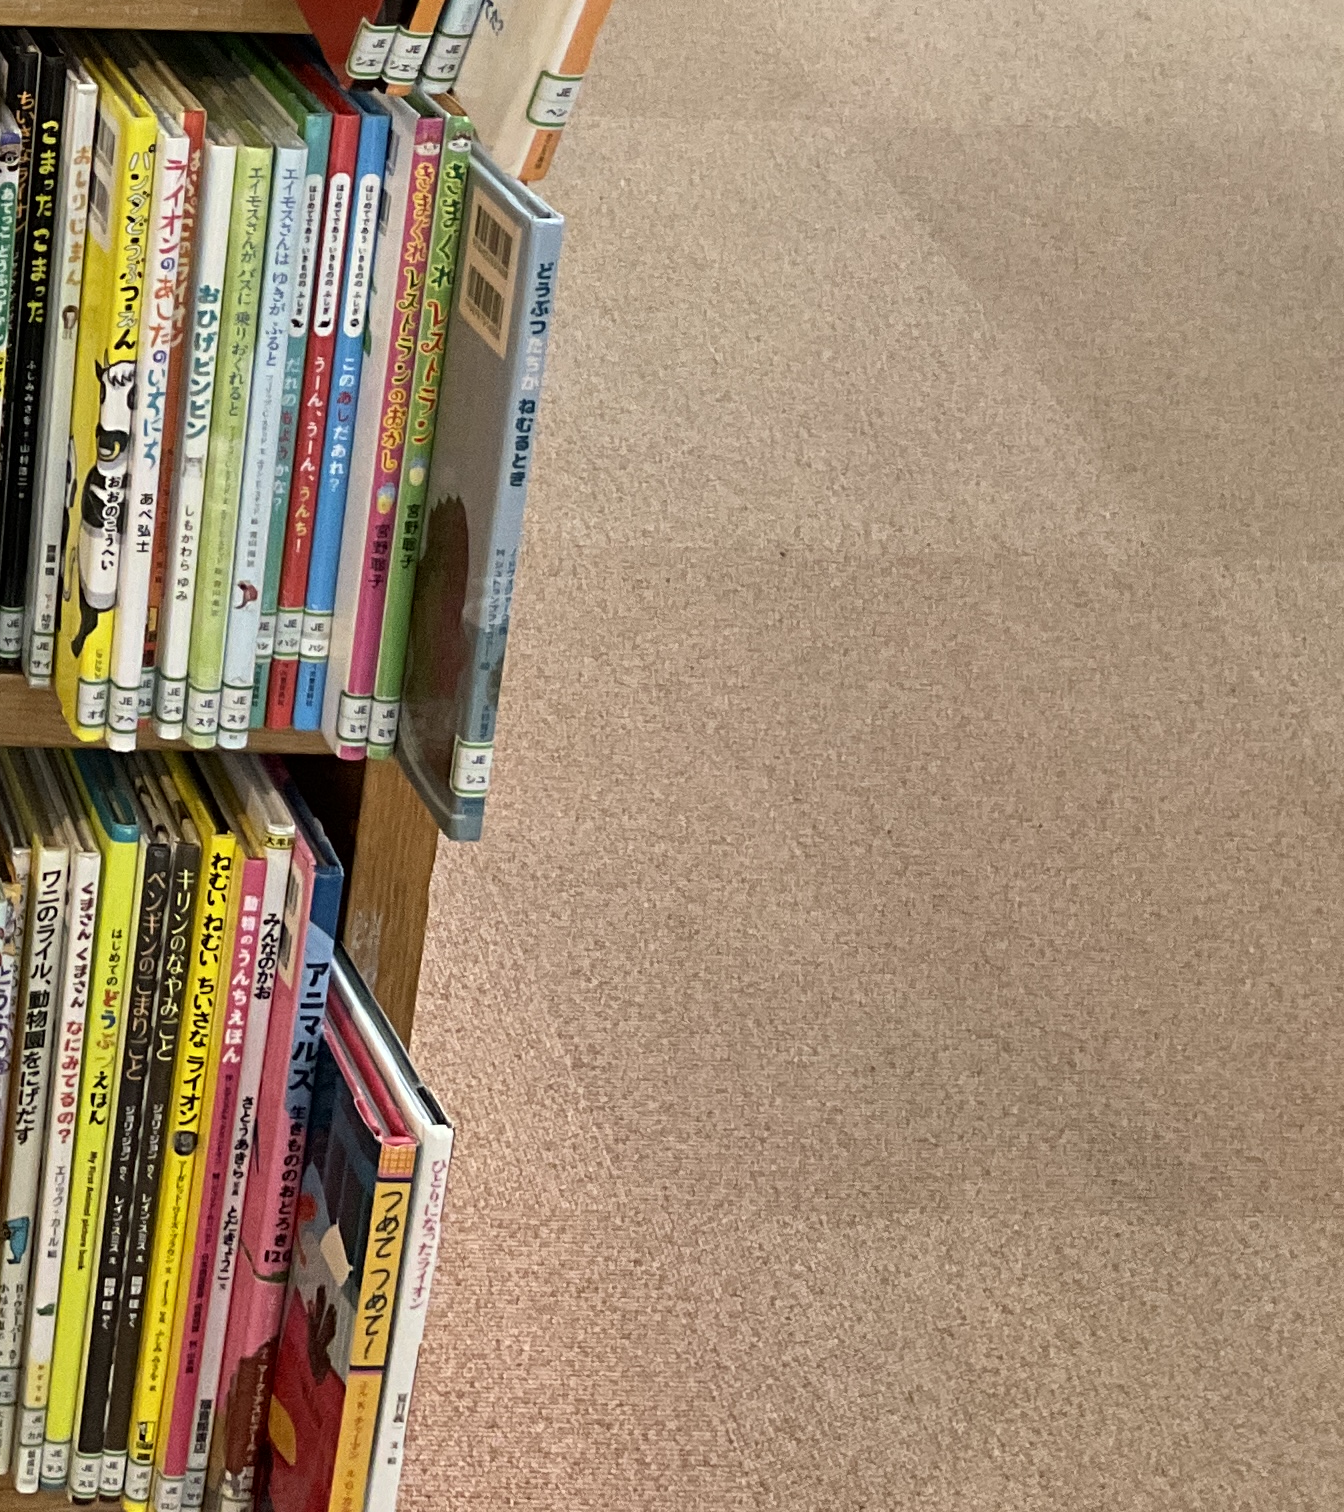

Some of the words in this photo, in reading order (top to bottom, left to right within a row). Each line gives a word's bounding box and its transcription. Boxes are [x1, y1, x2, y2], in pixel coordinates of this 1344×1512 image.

[372, 38, 386, 49] JE
[556, 87, 572, 98] JE
[35, 119, 59, 217] こまった
[65, 145, 92, 285] おしりじまん
[240, 166, 263, 264] エイモスさんが
[276, 167, 299, 265] エイモスさんは
[27, 227, 50, 324] こまった
[236, 267, 257, 306] バスに
[269, 272, 288, 316] ゆきが
[142, 159, 187, 470] ライオンのあしたのいちにち
[264, 324, 284, 367] ふると
[521, 262, 555, 392] どうぶつたちが
[228, 311, 250, 418] 乗りおくれると
[413, 300, 448, 445] レストラン
[509, 399, 537, 488] ねむるとき
[100, 475, 122, 570] おおのこうへい
[136, 492, 154, 553] あべ弘士
[180, 505, 194, 572] しもかわら
[6, 617, 20, 628] JE
[175, 577, 189, 602] ゆみ
[119, 696, 133, 706] JE
[233, 695, 247, 706] JE
[353, 704, 367, 715] JE
[77, 882, 95, 942] くまさん
[205, 852, 233, 908] ねむい
[125, 872, 167, 1081] ペンギンのこまりごと
[155, 869, 195, 1061] キリンのなやみごと
[198, 914, 224, 967] ねむい
[253, 913, 281, 1000] みんなのかお
[12, 870, 62, 1146] ワニのライル、動物園をにげだす
[71, 949, 88, 1008] くまさん
[188, 975, 217, 1050] ちいさな
[221, 894, 261, 1065] 動物のうんちえほん
[288, 962, 330, 1089] アニマルズ
[55, 1020, 84, 1145] なにみてるの?
[177, 1056, 205, 1127] ライオン
[374, 1189, 404, 1259] つめて
